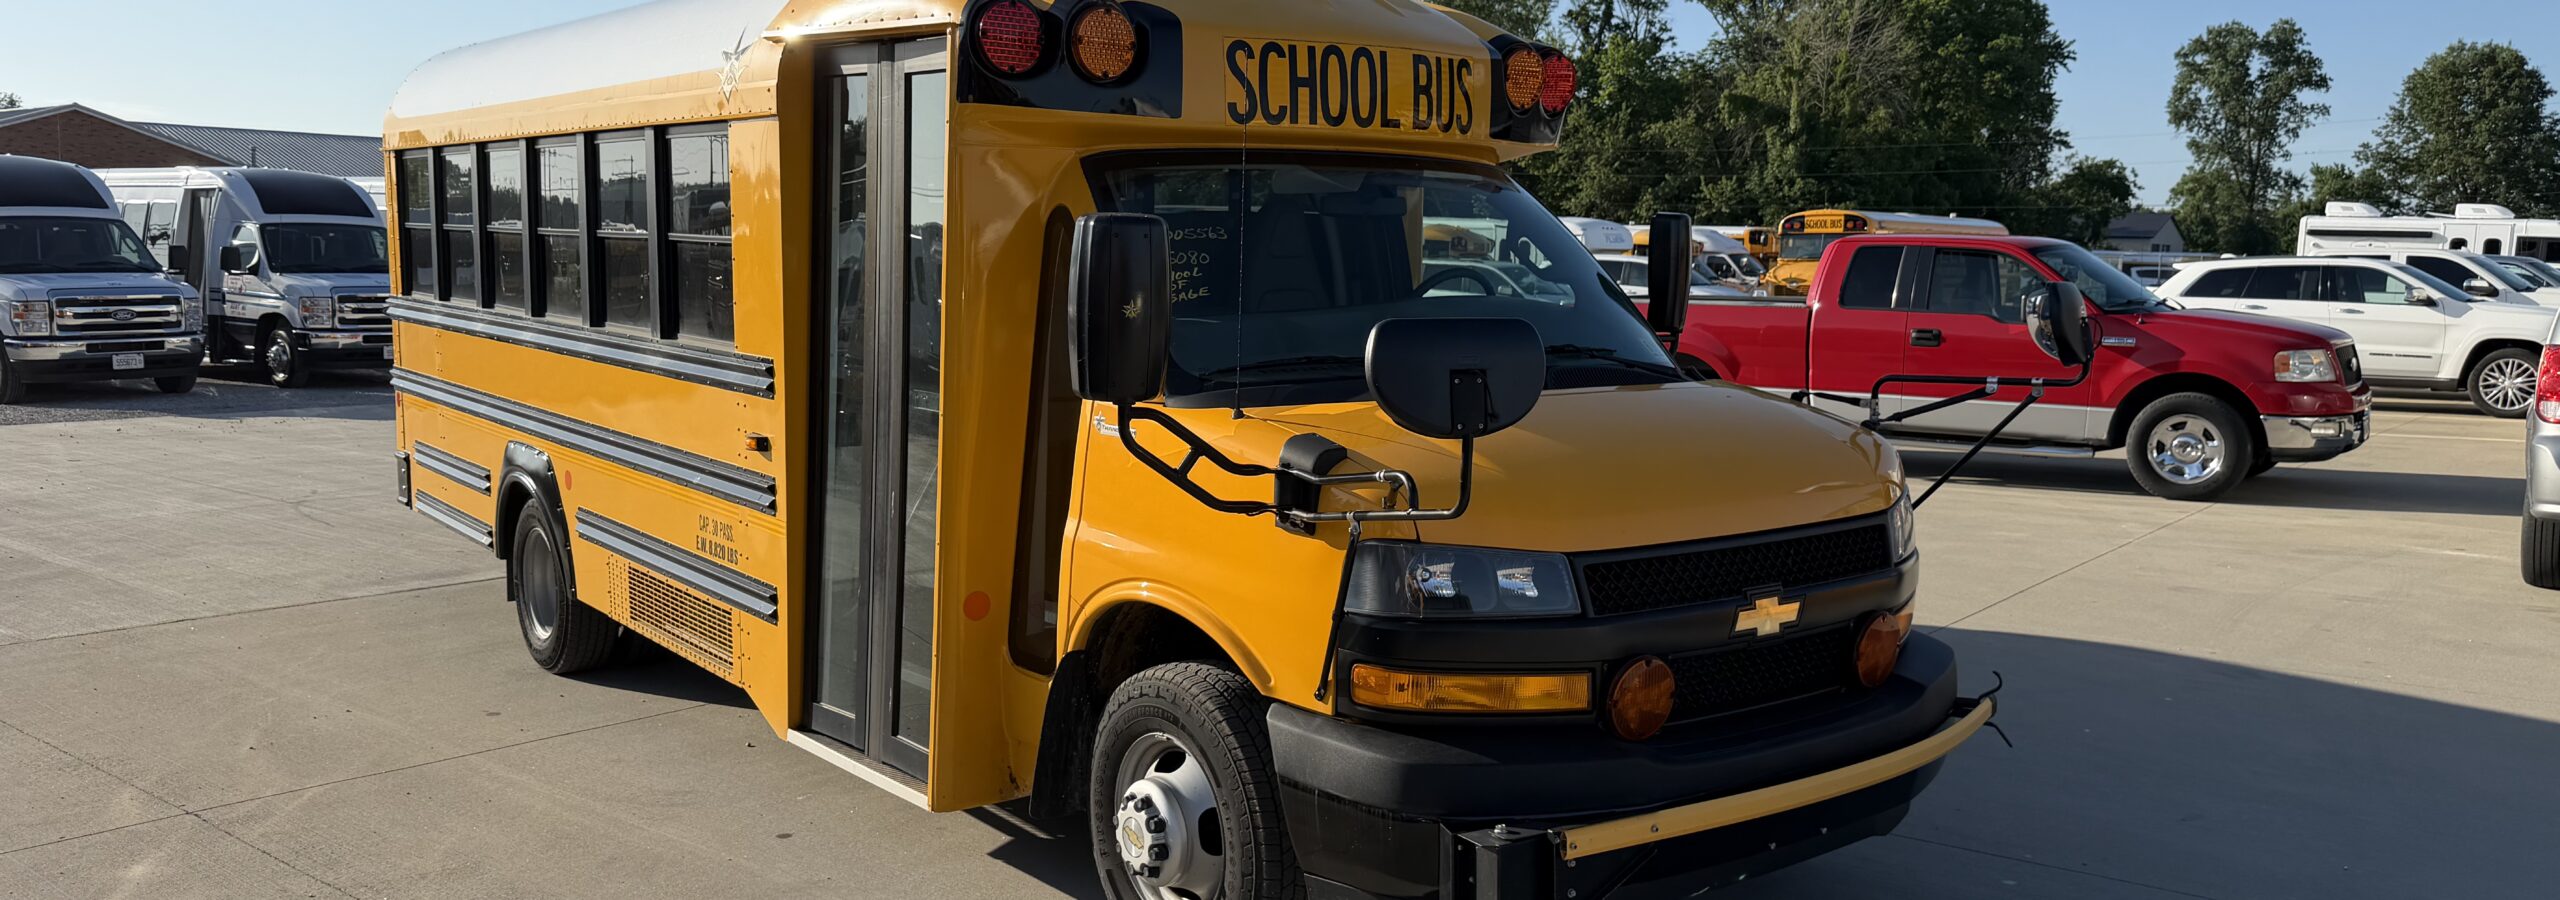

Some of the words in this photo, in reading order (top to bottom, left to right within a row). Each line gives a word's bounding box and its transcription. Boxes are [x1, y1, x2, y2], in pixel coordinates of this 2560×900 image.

[1225, 39, 1401, 129] SCHOOL
[1412, 53, 1473, 135] BUS
[1805, 218, 1828, 229] SCHOOL
[1829, 218, 1843, 229] BUS
[727, 546, 739, 566] LBS
